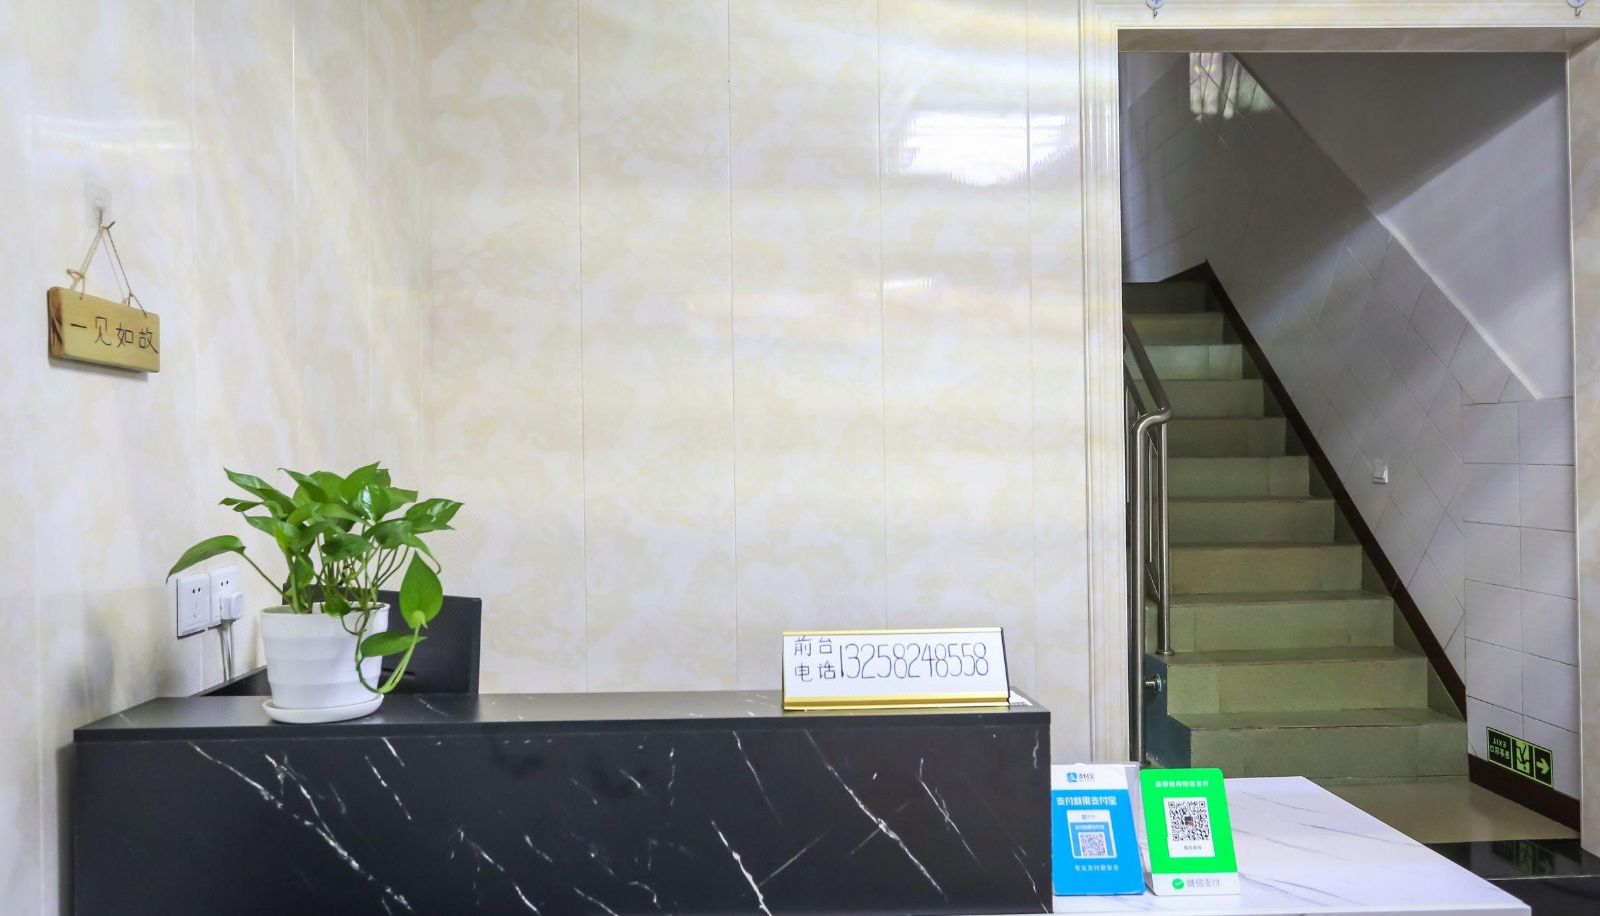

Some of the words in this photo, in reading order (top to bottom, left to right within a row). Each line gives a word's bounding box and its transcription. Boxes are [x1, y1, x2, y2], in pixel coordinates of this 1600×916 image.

[70, 316, 159, 354] 一见如故
[793, 635, 833, 657] 前台
[794, 660, 836, 682] 电话
[840, 643, 988, 679] 13258248558
[1493, 738, 1507, 748] EXIT
